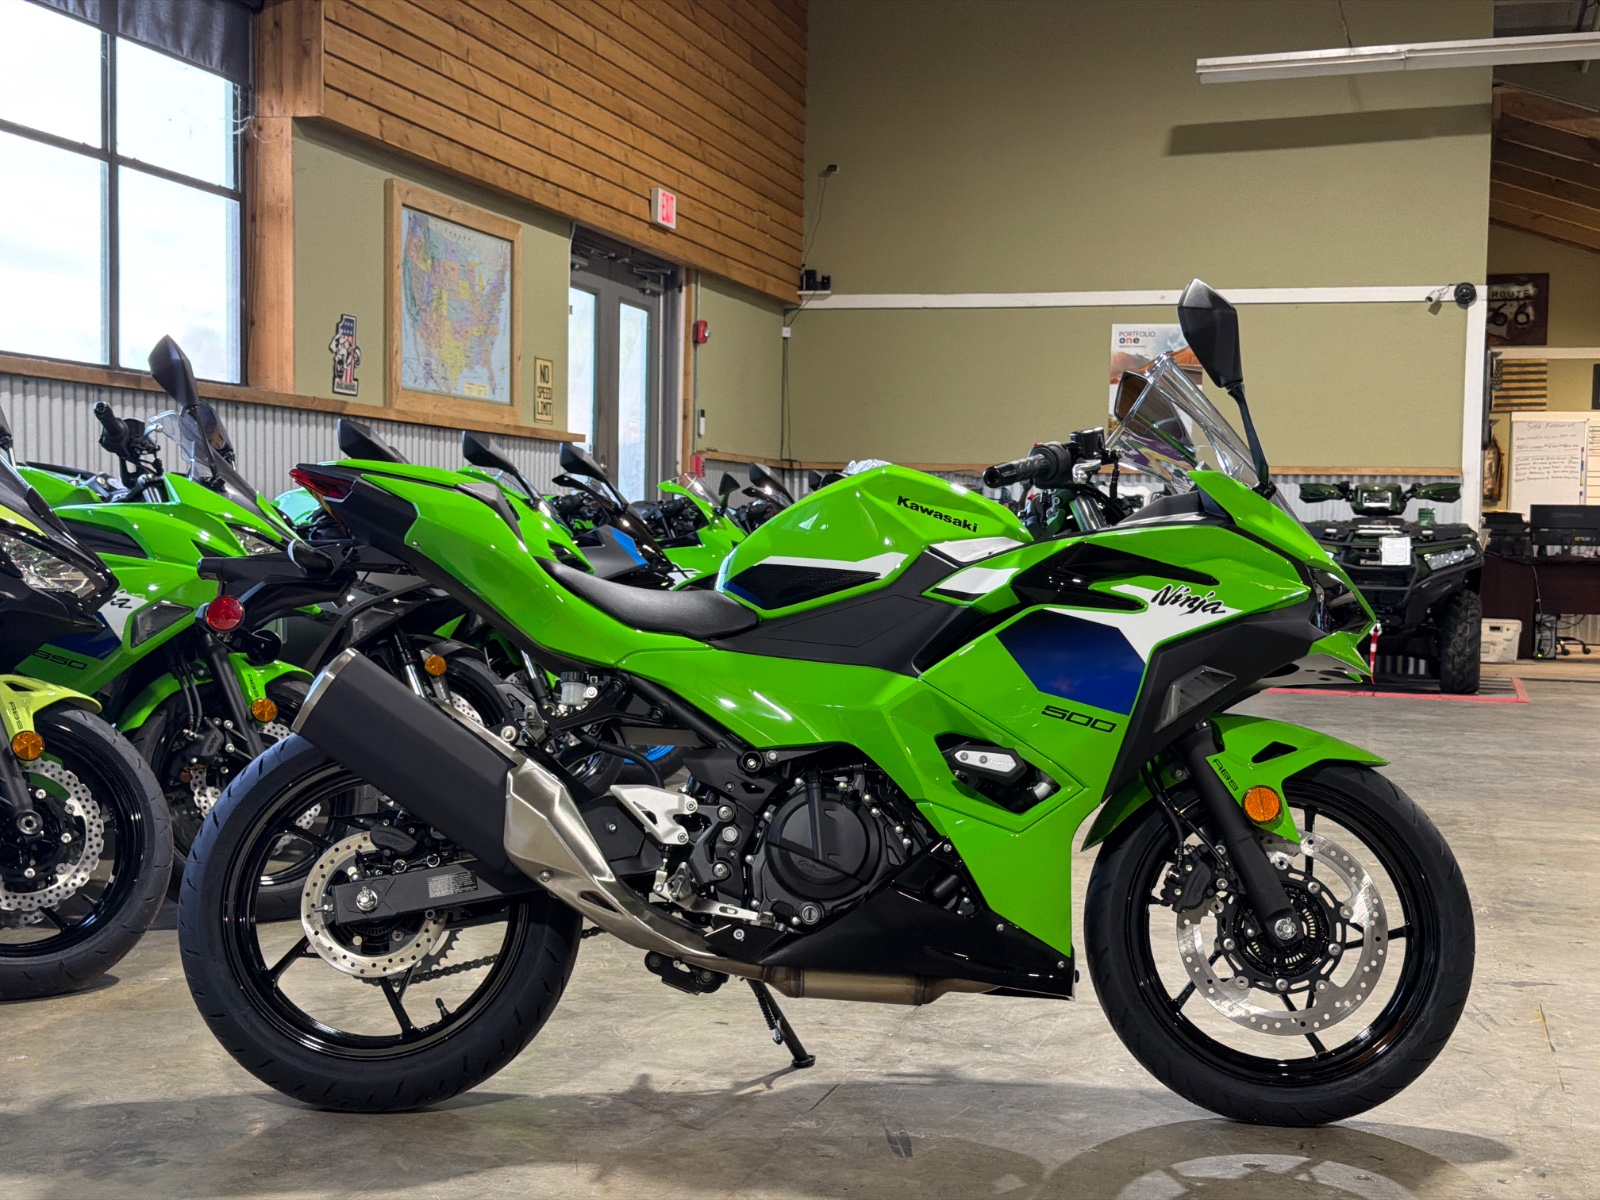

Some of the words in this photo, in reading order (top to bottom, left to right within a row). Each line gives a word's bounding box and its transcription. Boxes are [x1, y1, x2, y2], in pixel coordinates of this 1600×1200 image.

[1491, 289, 1531, 299] ROUTE
[540, 364, 549, 384] NO
[897, 495, 978, 533] Kawasaki
[1150, 585, 1226, 616] Ninja
[9, 701, 24, 730] ABS
[1041, 705, 1117, 733] 500
[1213, 759, 1239, 791] ABS
